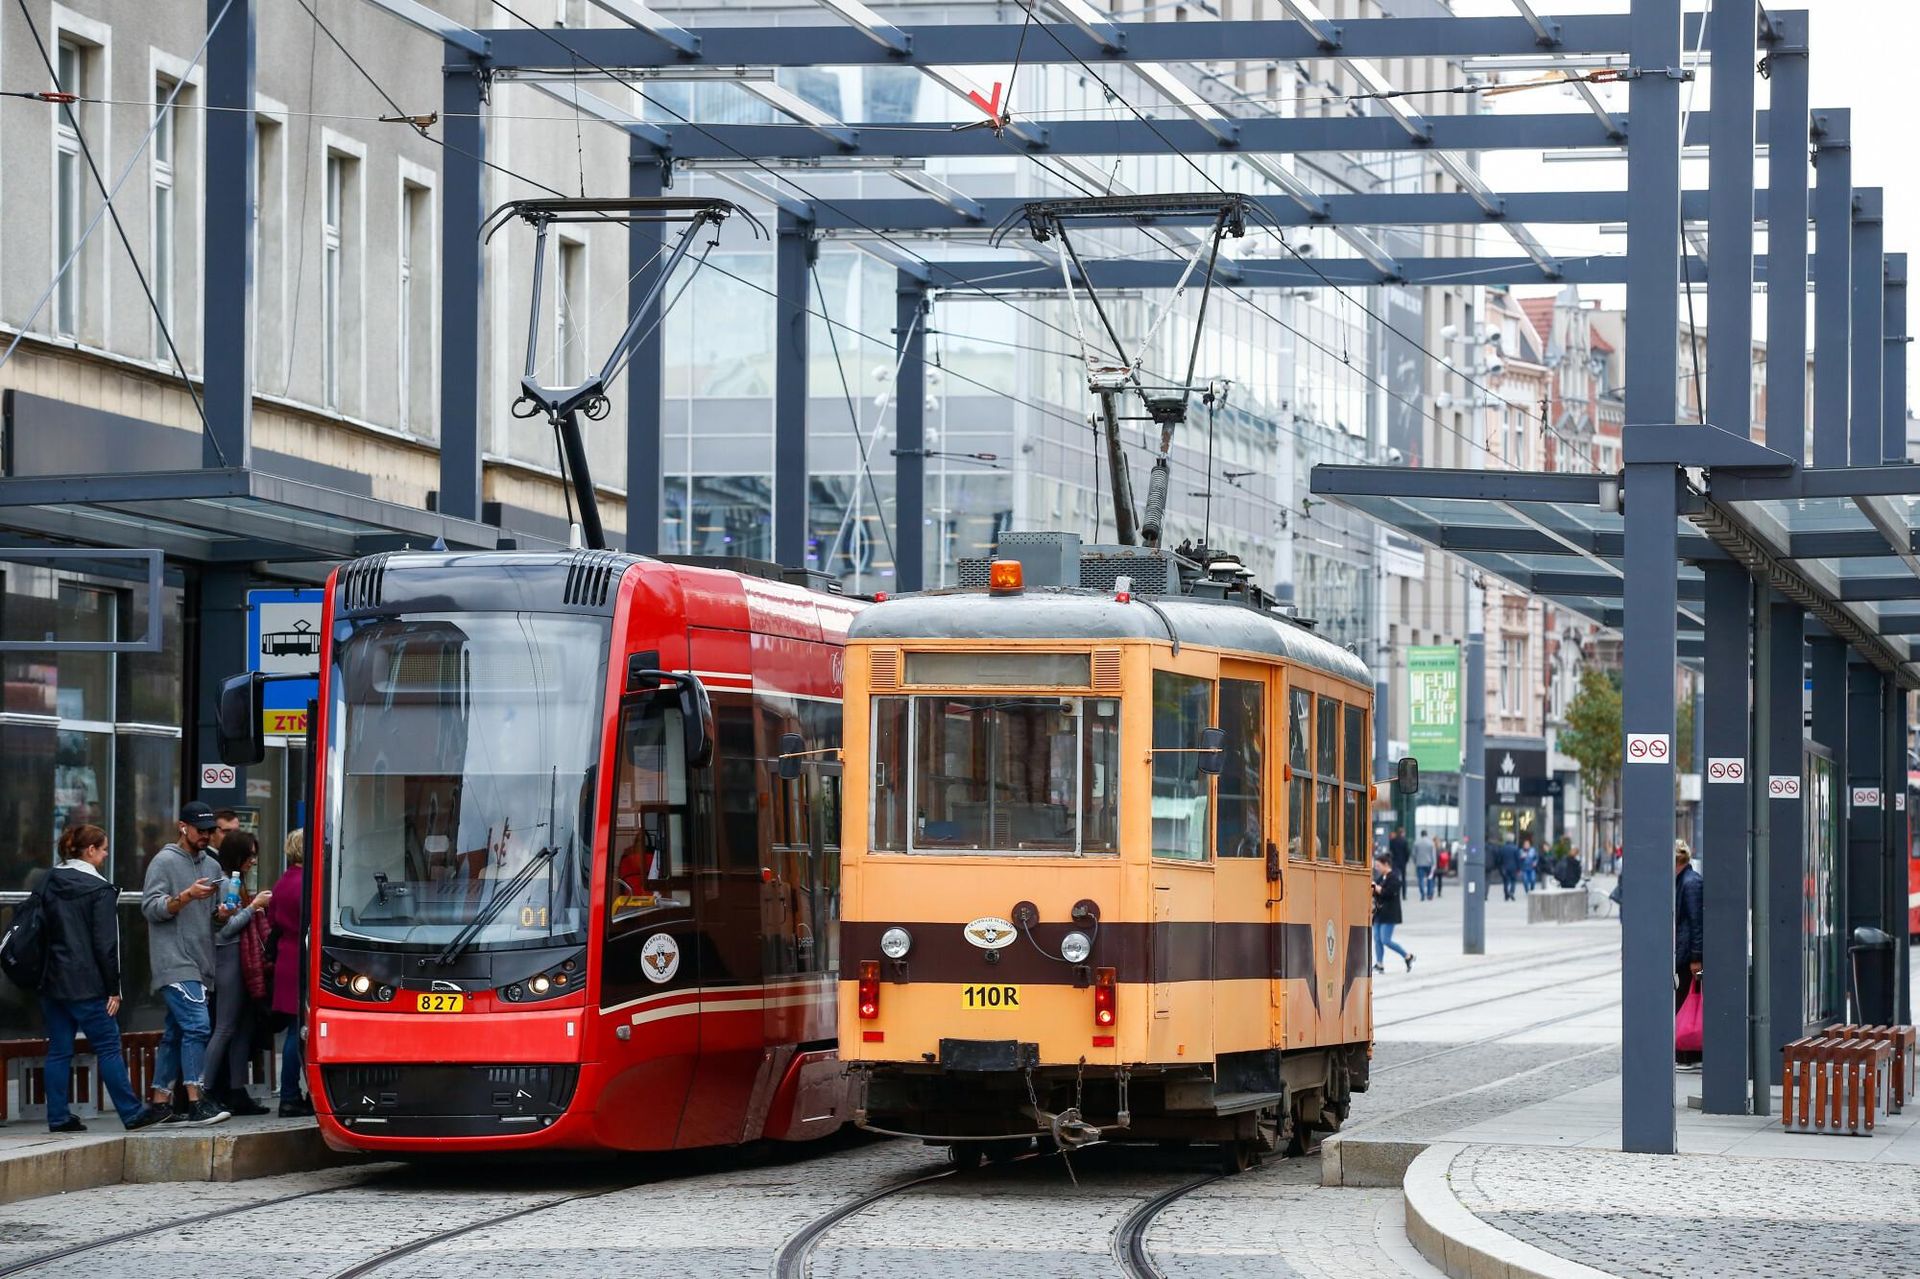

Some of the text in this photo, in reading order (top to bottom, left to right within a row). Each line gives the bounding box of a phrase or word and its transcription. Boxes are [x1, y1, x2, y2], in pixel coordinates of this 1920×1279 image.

[521, 906, 547, 927] 01
[421, 995, 458, 1011] 827
[964, 986, 1020, 1007] 110R
